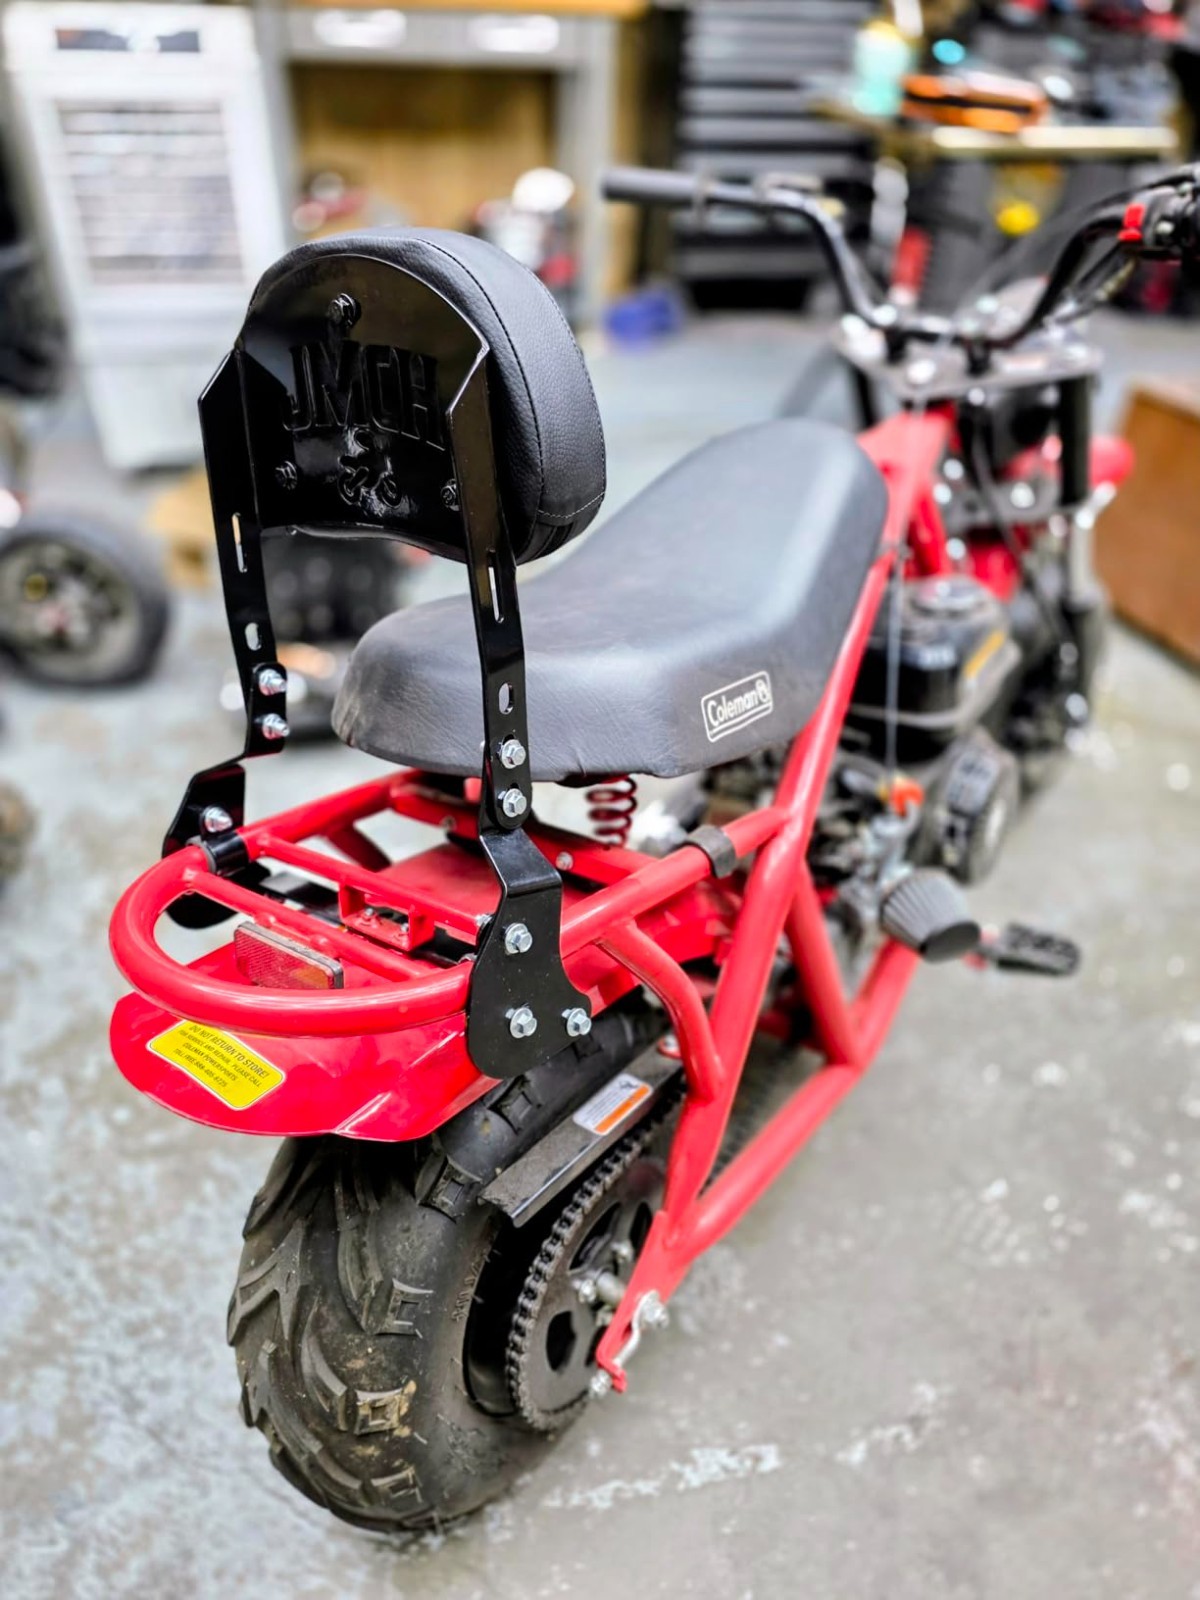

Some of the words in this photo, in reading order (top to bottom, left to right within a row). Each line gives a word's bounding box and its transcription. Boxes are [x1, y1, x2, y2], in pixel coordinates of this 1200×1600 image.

[707, 689, 759, 727] Coleman
[182, 1042, 205, 1056] COLEMAN
[203, 1054, 238, 1081] POWERSPORTS
[189, 1025, 201, 1033] DO
[199, 1030, 215, 1039] NOT
[210, 1036, 236, 1055] RETURN
[233, 1052, 246, 1061] TO
[242, 1059, 270, 1078] STORE!
[204, 1043, 215, 1052] AND
[232, 1064, 251, 1078] PLEASE
[248, 1076, 262, 1087] CALL
